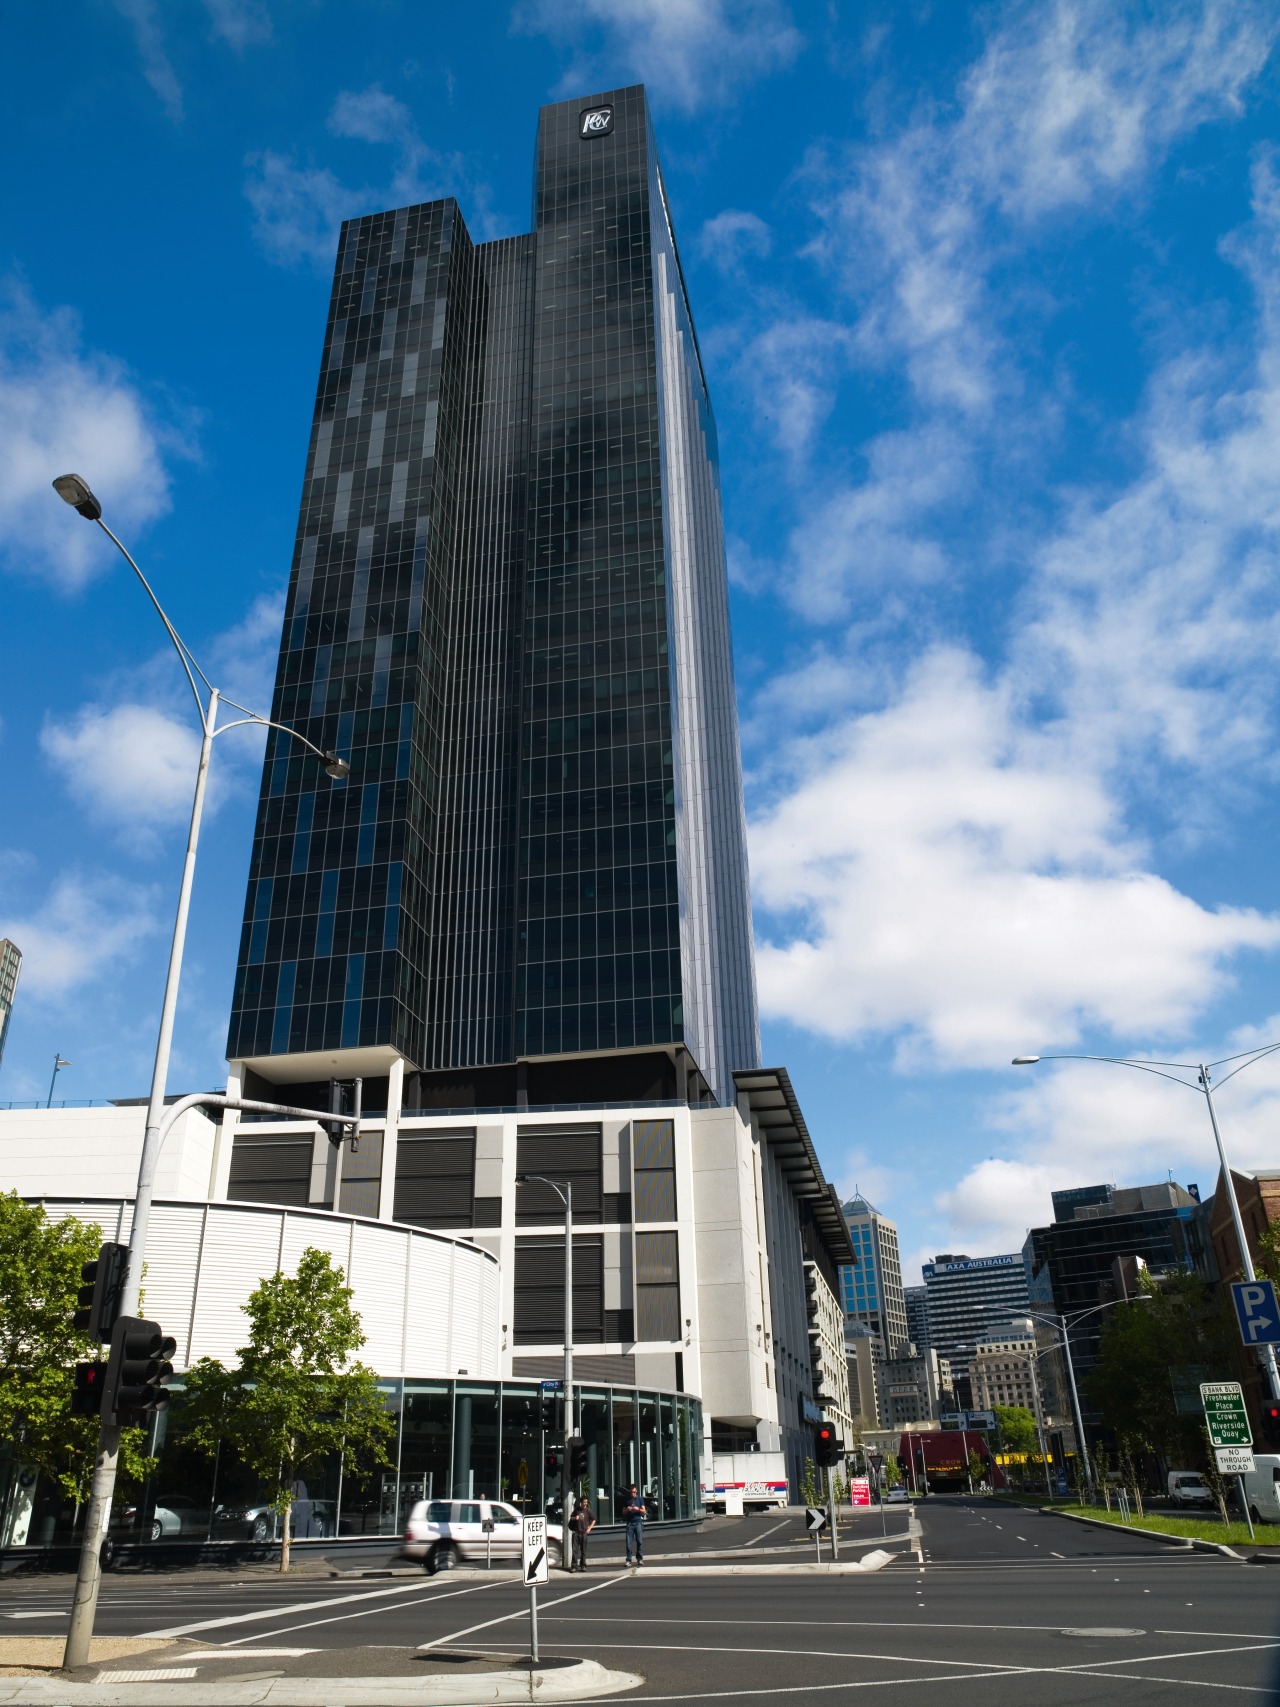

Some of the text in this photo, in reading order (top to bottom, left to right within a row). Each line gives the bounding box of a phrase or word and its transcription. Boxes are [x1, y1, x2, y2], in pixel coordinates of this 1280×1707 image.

[967, 1257, 1012, 1268] AUSTRALIA
[1241, 1286, 1266, 1316] P
[1205, 1394, 1240, 1402] Freshwater
[1216, 1413, 1238, 1421] Crown
[1212, 1422, 1245, 1430] Riverside
[1221, 1430, 1239, 1438] Quay
[527, 1521, 544, 1532] KEEP
[528, 1535, 543, 1546] LEFT
